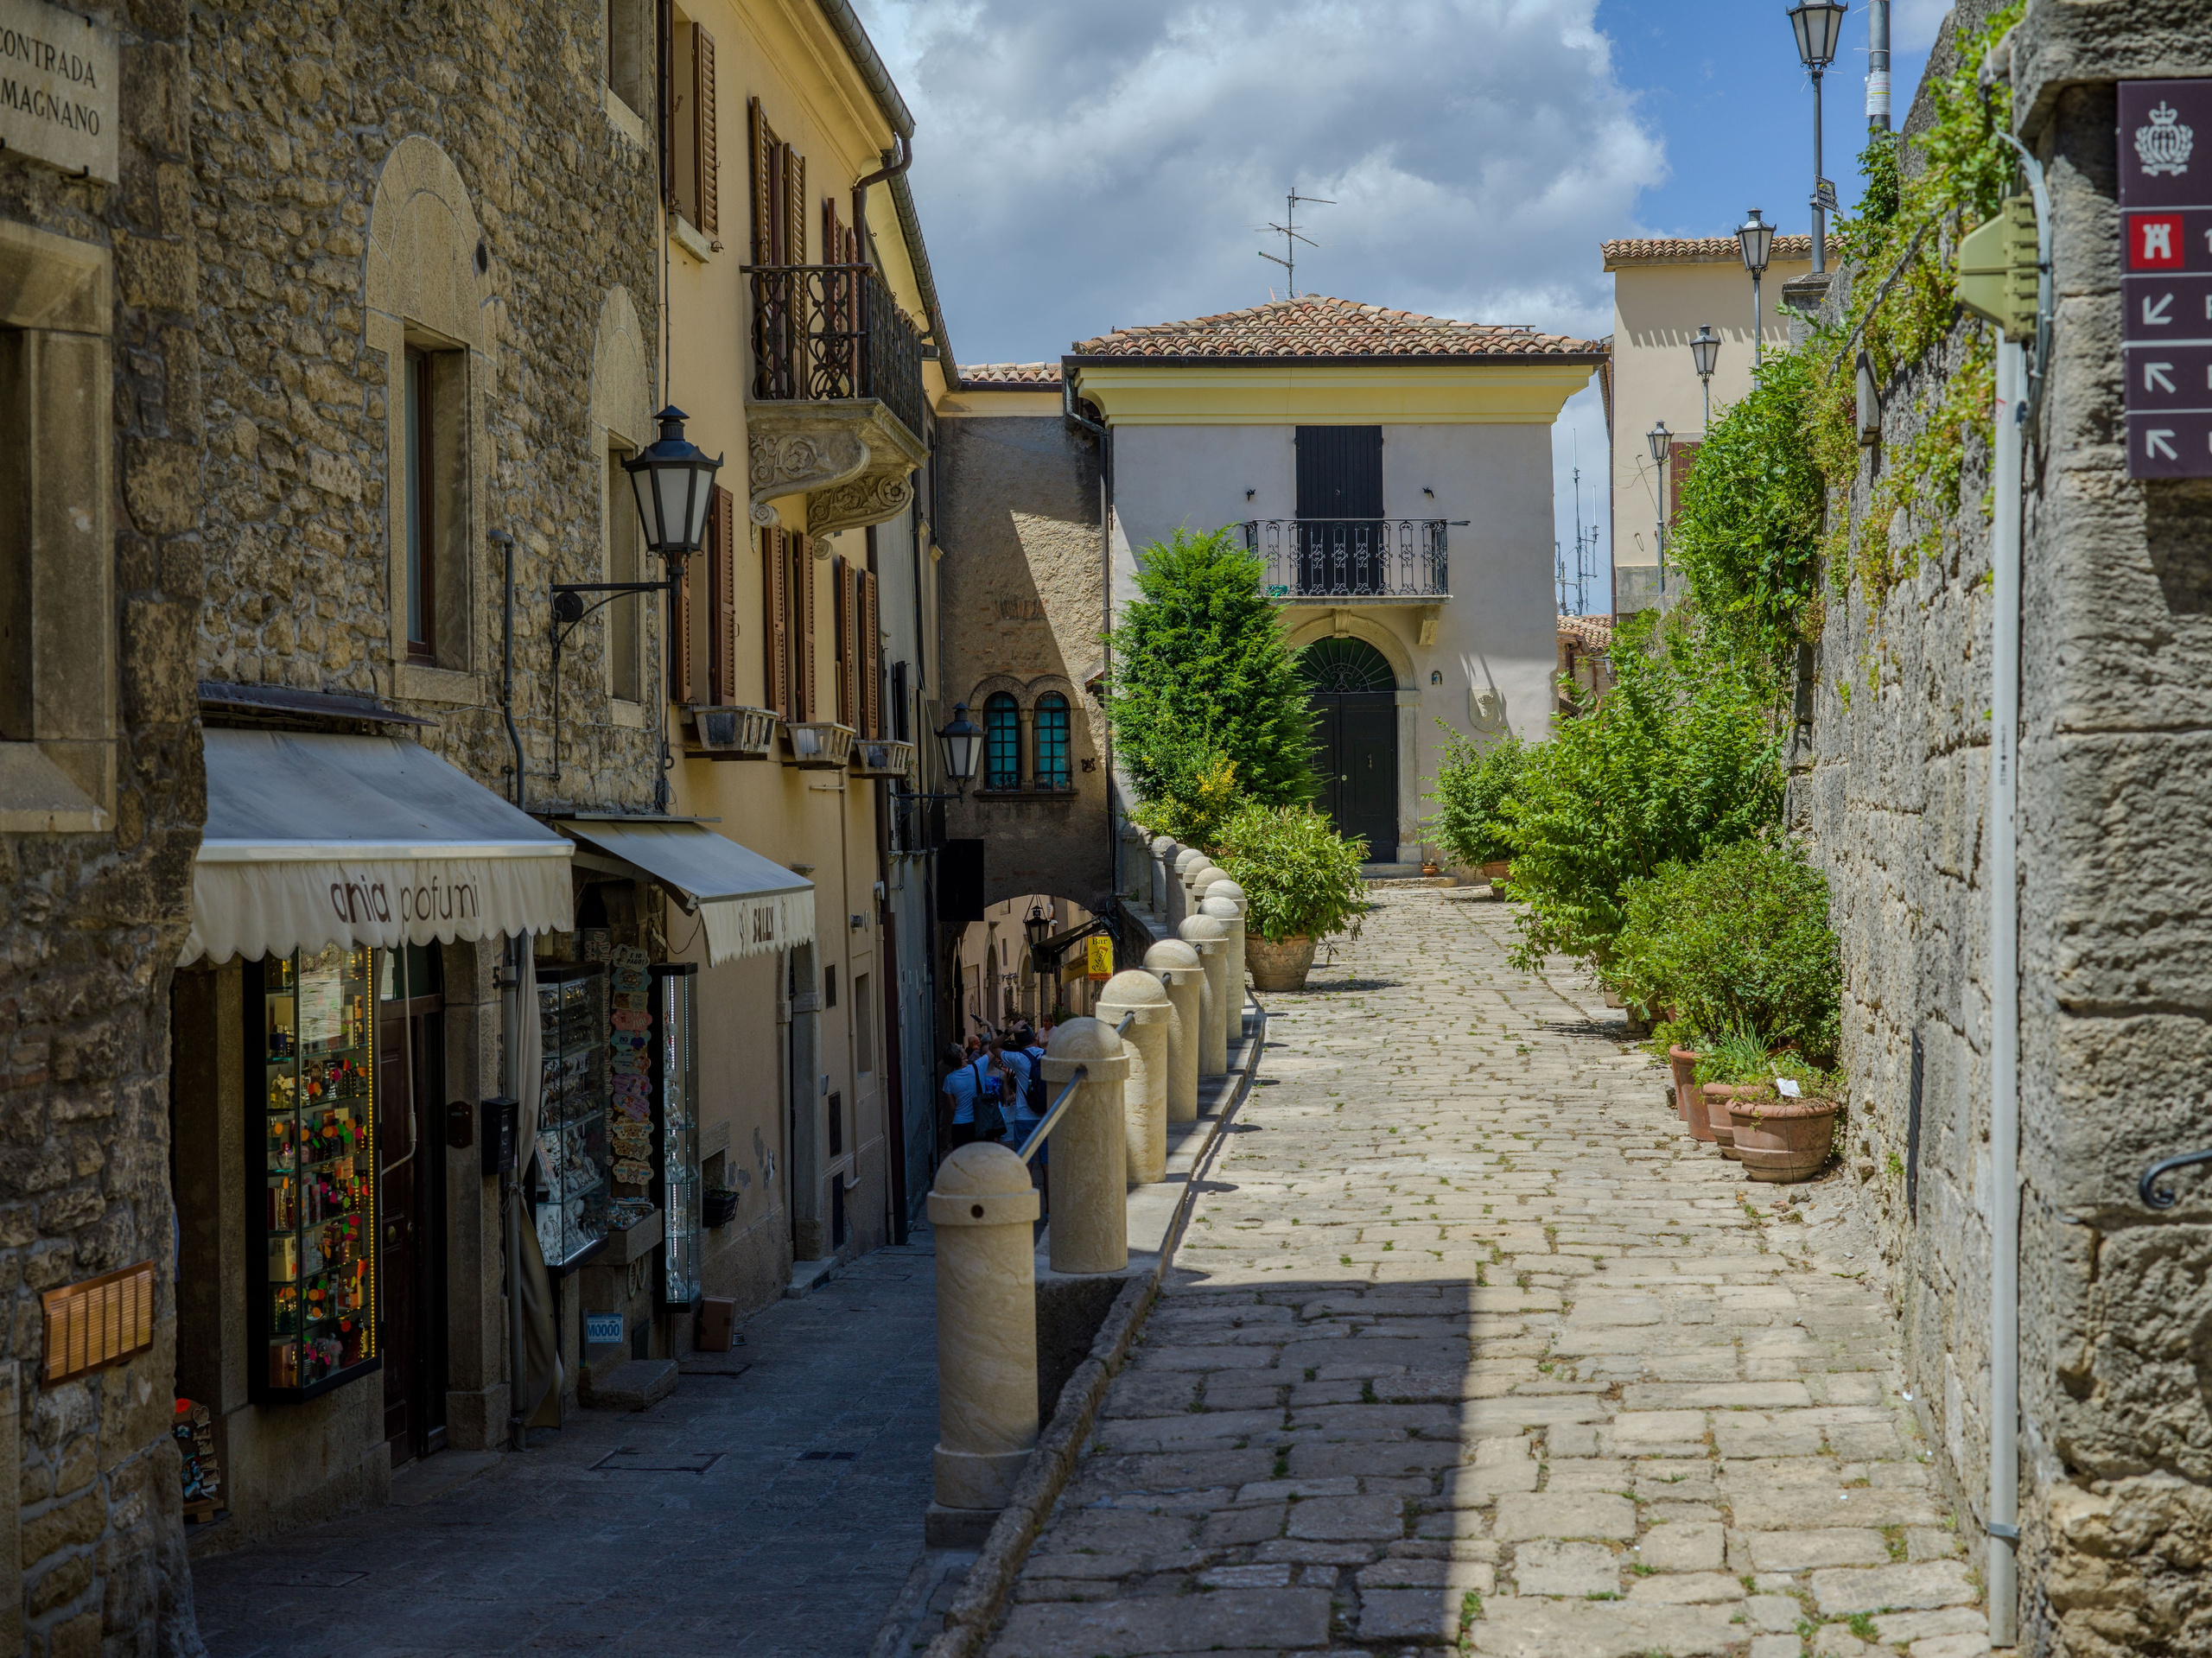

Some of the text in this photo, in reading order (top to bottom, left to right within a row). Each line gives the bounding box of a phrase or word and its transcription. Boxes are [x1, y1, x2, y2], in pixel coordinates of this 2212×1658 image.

[1, 77, 100, 136] MAGNANO
[330, 874, 480, 935] ania pofumi
